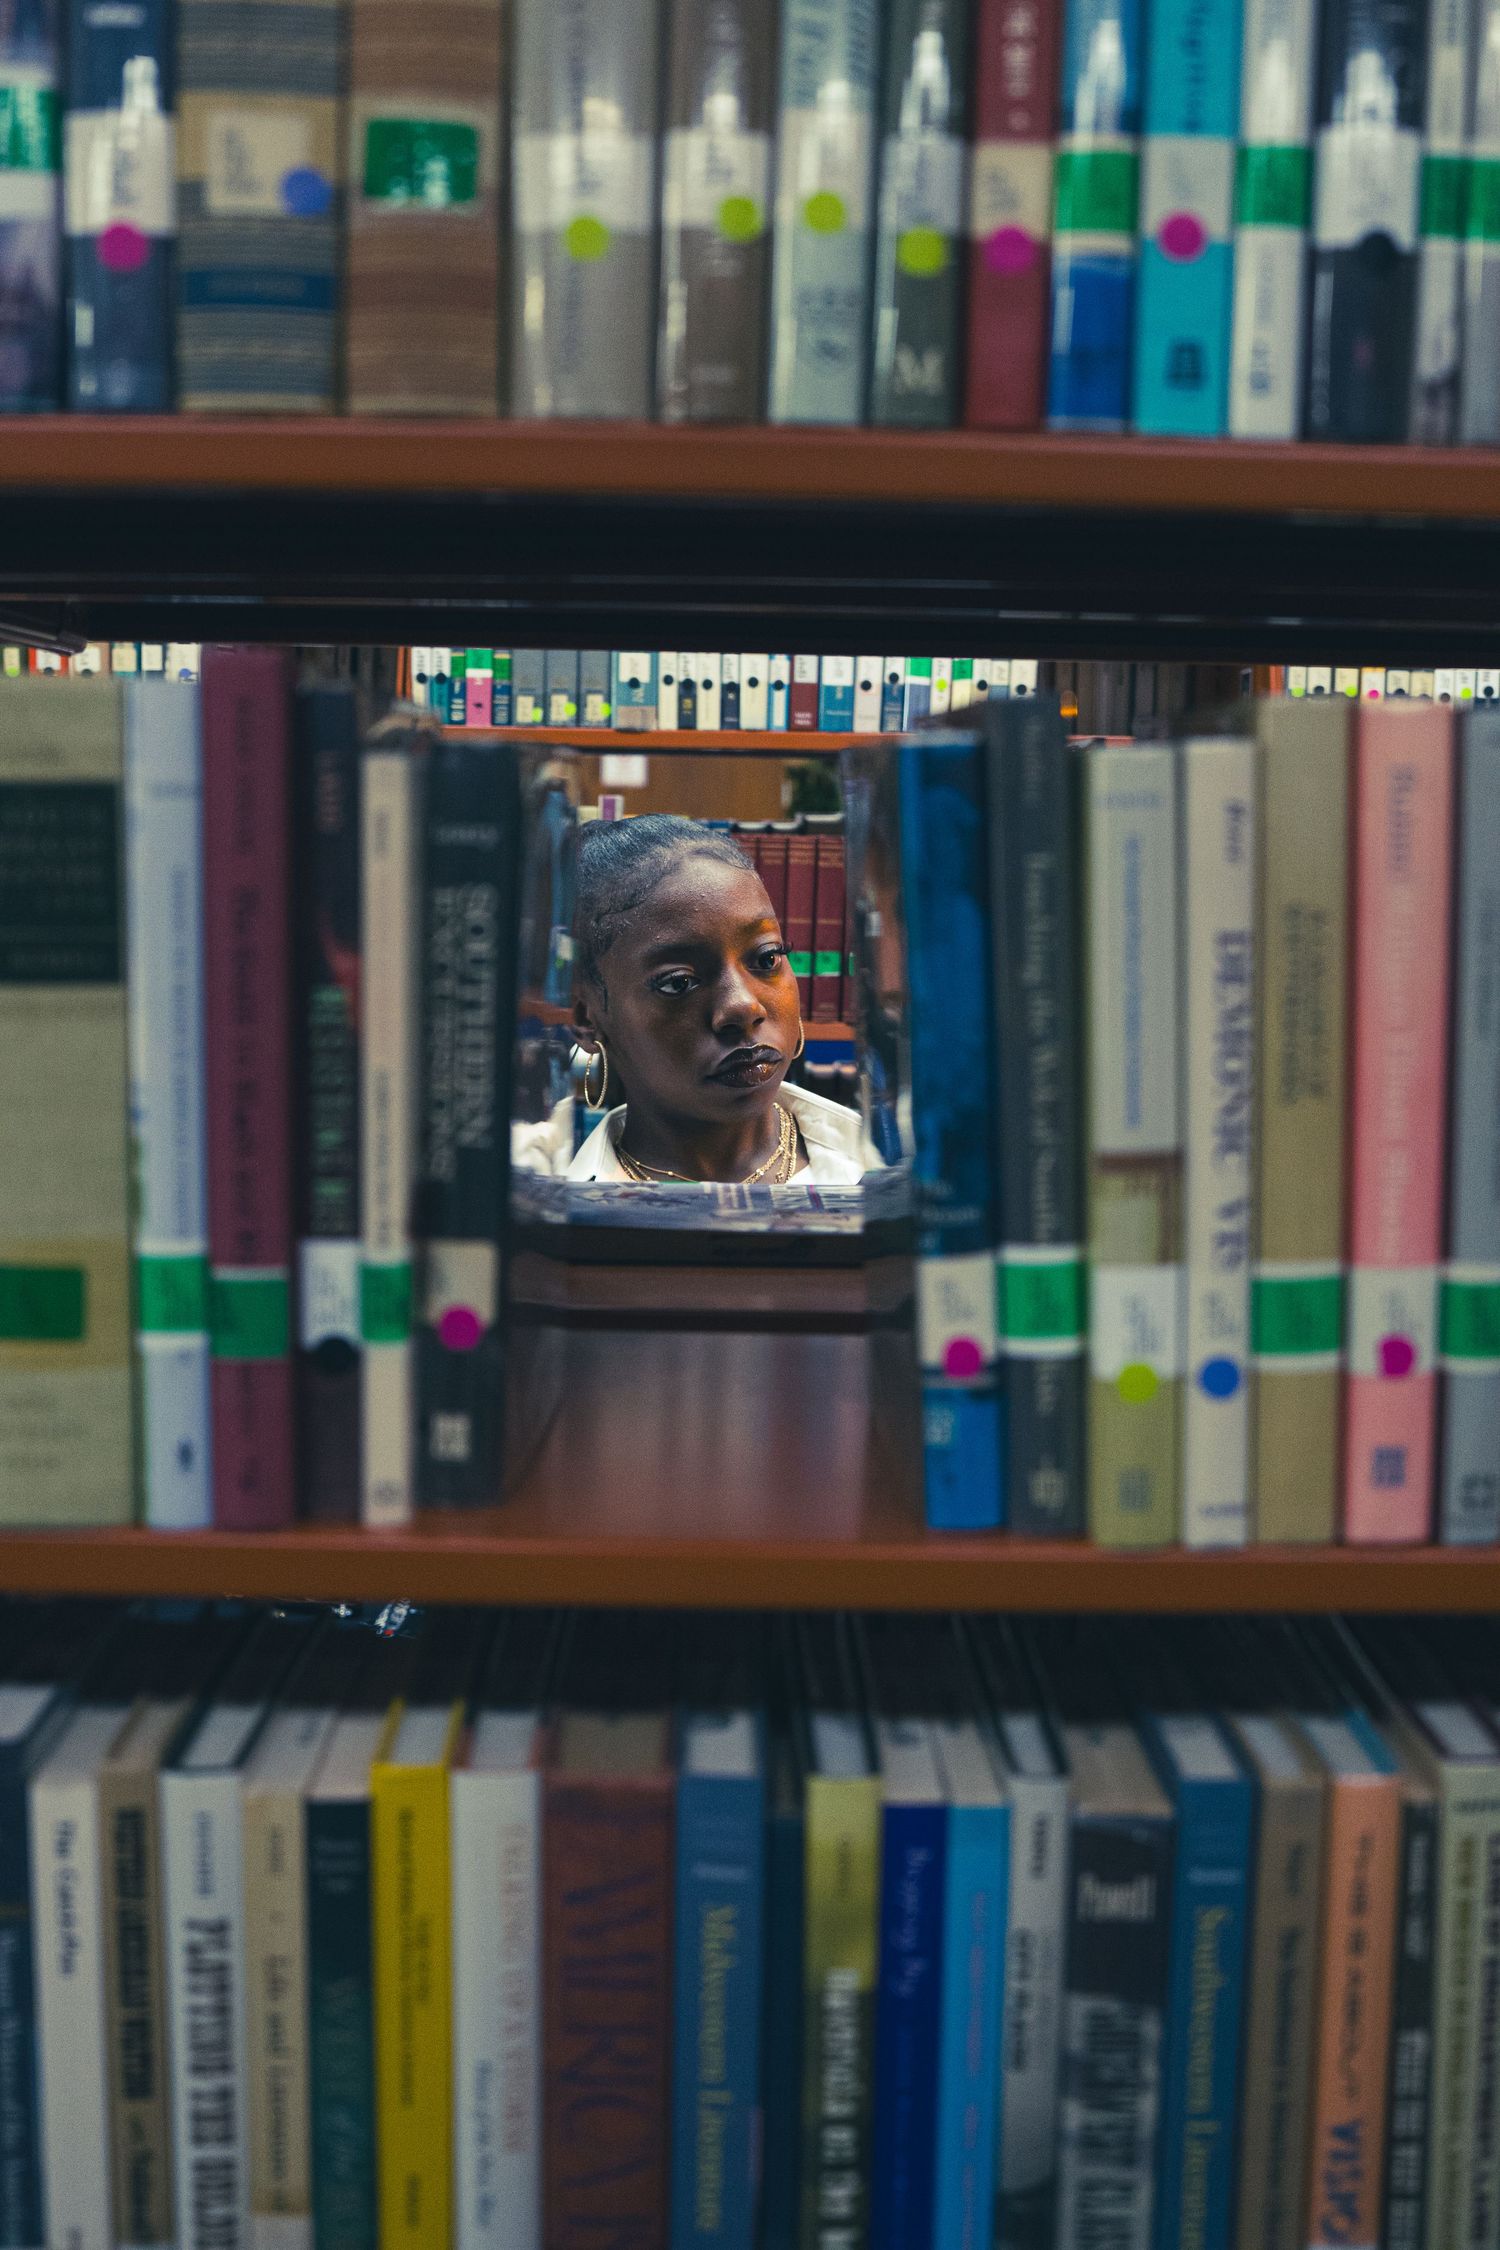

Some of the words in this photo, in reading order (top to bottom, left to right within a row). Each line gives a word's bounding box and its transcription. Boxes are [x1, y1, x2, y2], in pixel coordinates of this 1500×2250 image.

[456, 882, 498, 1150] SOUTHERN
[1079, 1875, 1155, 1920] Powell
[698, 1903, 736, 2085] Midwestern
[1184, 1905, 1231, 2111] Southwestern
[696, 2089, 734, 2233] Literature
